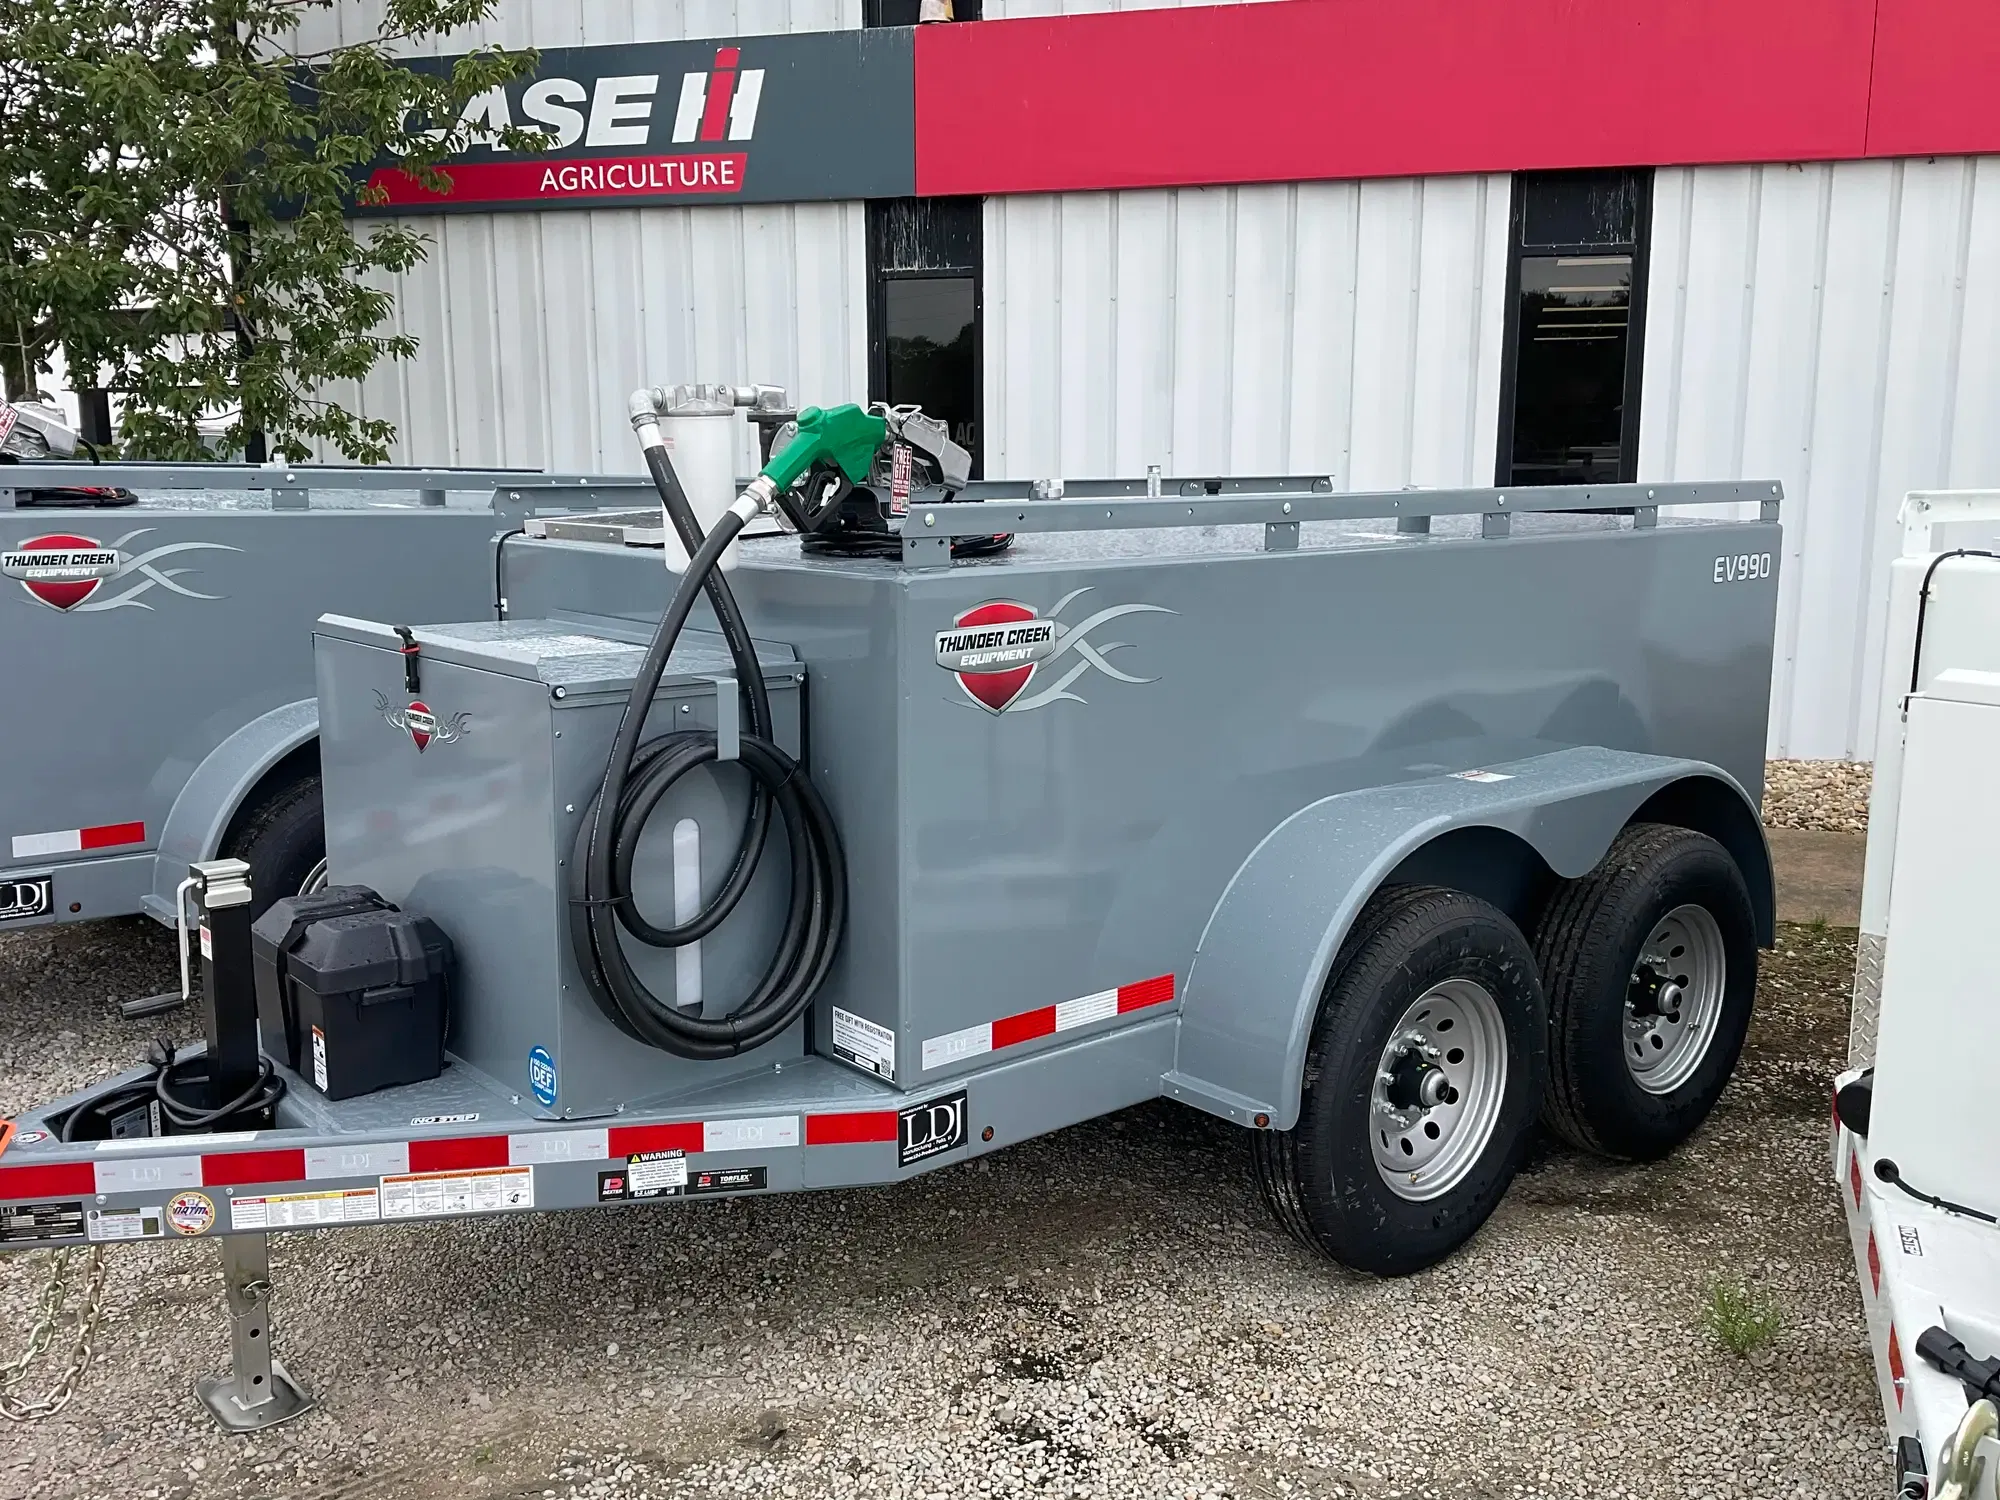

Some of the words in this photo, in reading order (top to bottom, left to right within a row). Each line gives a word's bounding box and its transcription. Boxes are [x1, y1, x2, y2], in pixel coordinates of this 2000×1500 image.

[540, 160, 735, 192] AGRICULTURE
[895, 448, 911, 465] FREE
[894, 464, 910, 480] GIFT
[5, 555, 68, 567] THUNDER
[71, 553, 115, 565] CREEK
[1713, 552, 1771, 583] EV990
[26, 567, 98, 578] EQUIPMENT
[938, 631, 1004, 653] THUNDER
[1007, 626, 1052, 646] CREEK
[960, 648, 1034, 667] EQUIPMENT
[835, 1011, 845, 1021] FREE
[845, 1015, 854, 1025] GIFT
[854, 1019, 864, 1030] WITH
[864, 1023, 893, 1042] REGISTRATION
[533, 1065, 553, 1088] DEF
[414, 1115, 434, 1125] NO
[437, 1113, 476, 1124] STEP
[903, 1097, 966, 1151] LDJ
[641, 1150, 683, 1162] WARNING
[720, 1174, 750, 1183] TORFLEX
